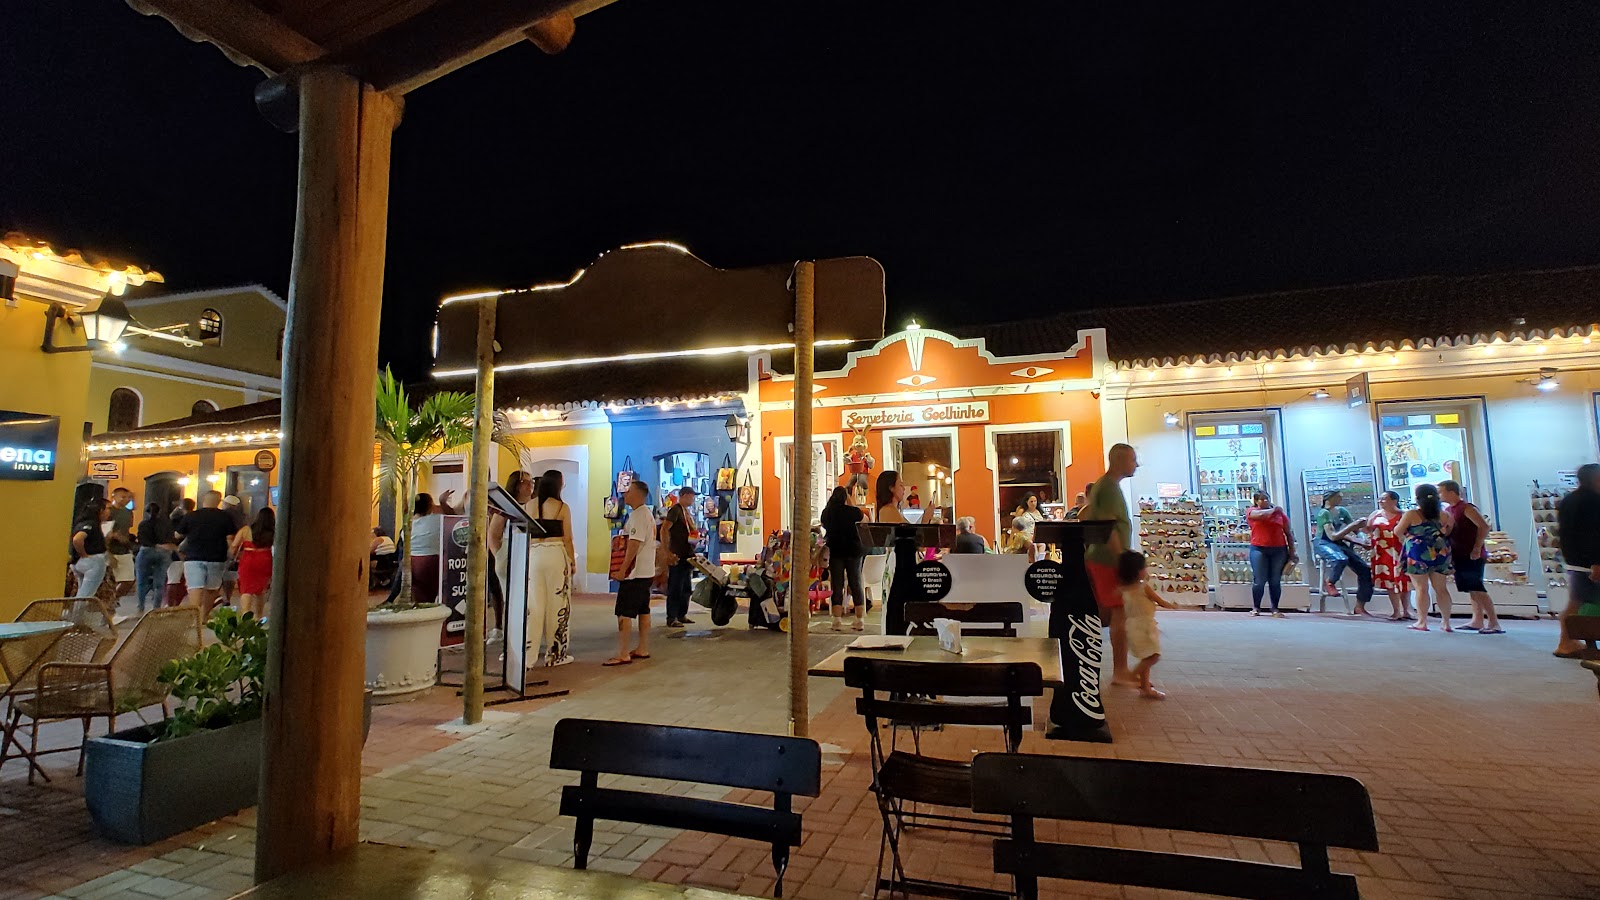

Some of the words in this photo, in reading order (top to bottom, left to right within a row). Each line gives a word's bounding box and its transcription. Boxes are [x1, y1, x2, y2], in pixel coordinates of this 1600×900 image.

[0, 447, 51, 464] ena
[14, 462, 50, 471] invest
[452, 586, 467, 597] SUS
